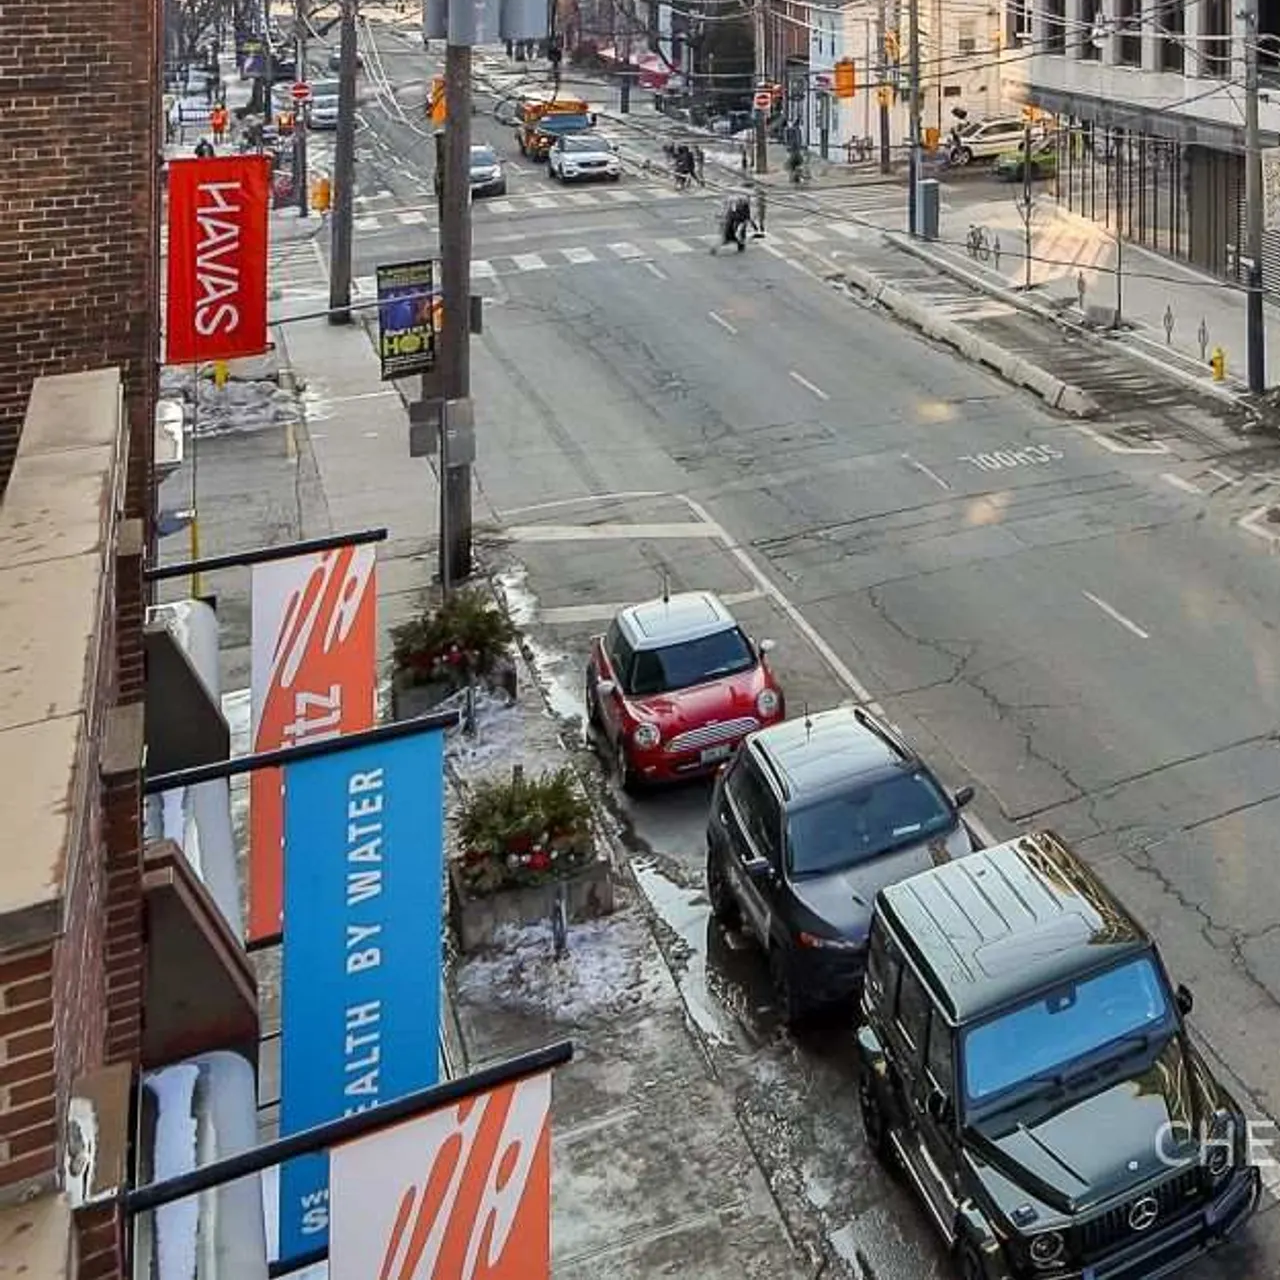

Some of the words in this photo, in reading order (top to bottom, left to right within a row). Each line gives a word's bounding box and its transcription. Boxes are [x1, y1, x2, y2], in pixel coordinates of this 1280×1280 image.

[194, 181, 241, 335] HAVAS
[384, 331, 433, 358] HOT
[346, 767, 384, 907] WATER
[346, 924, 382, 974] BY
